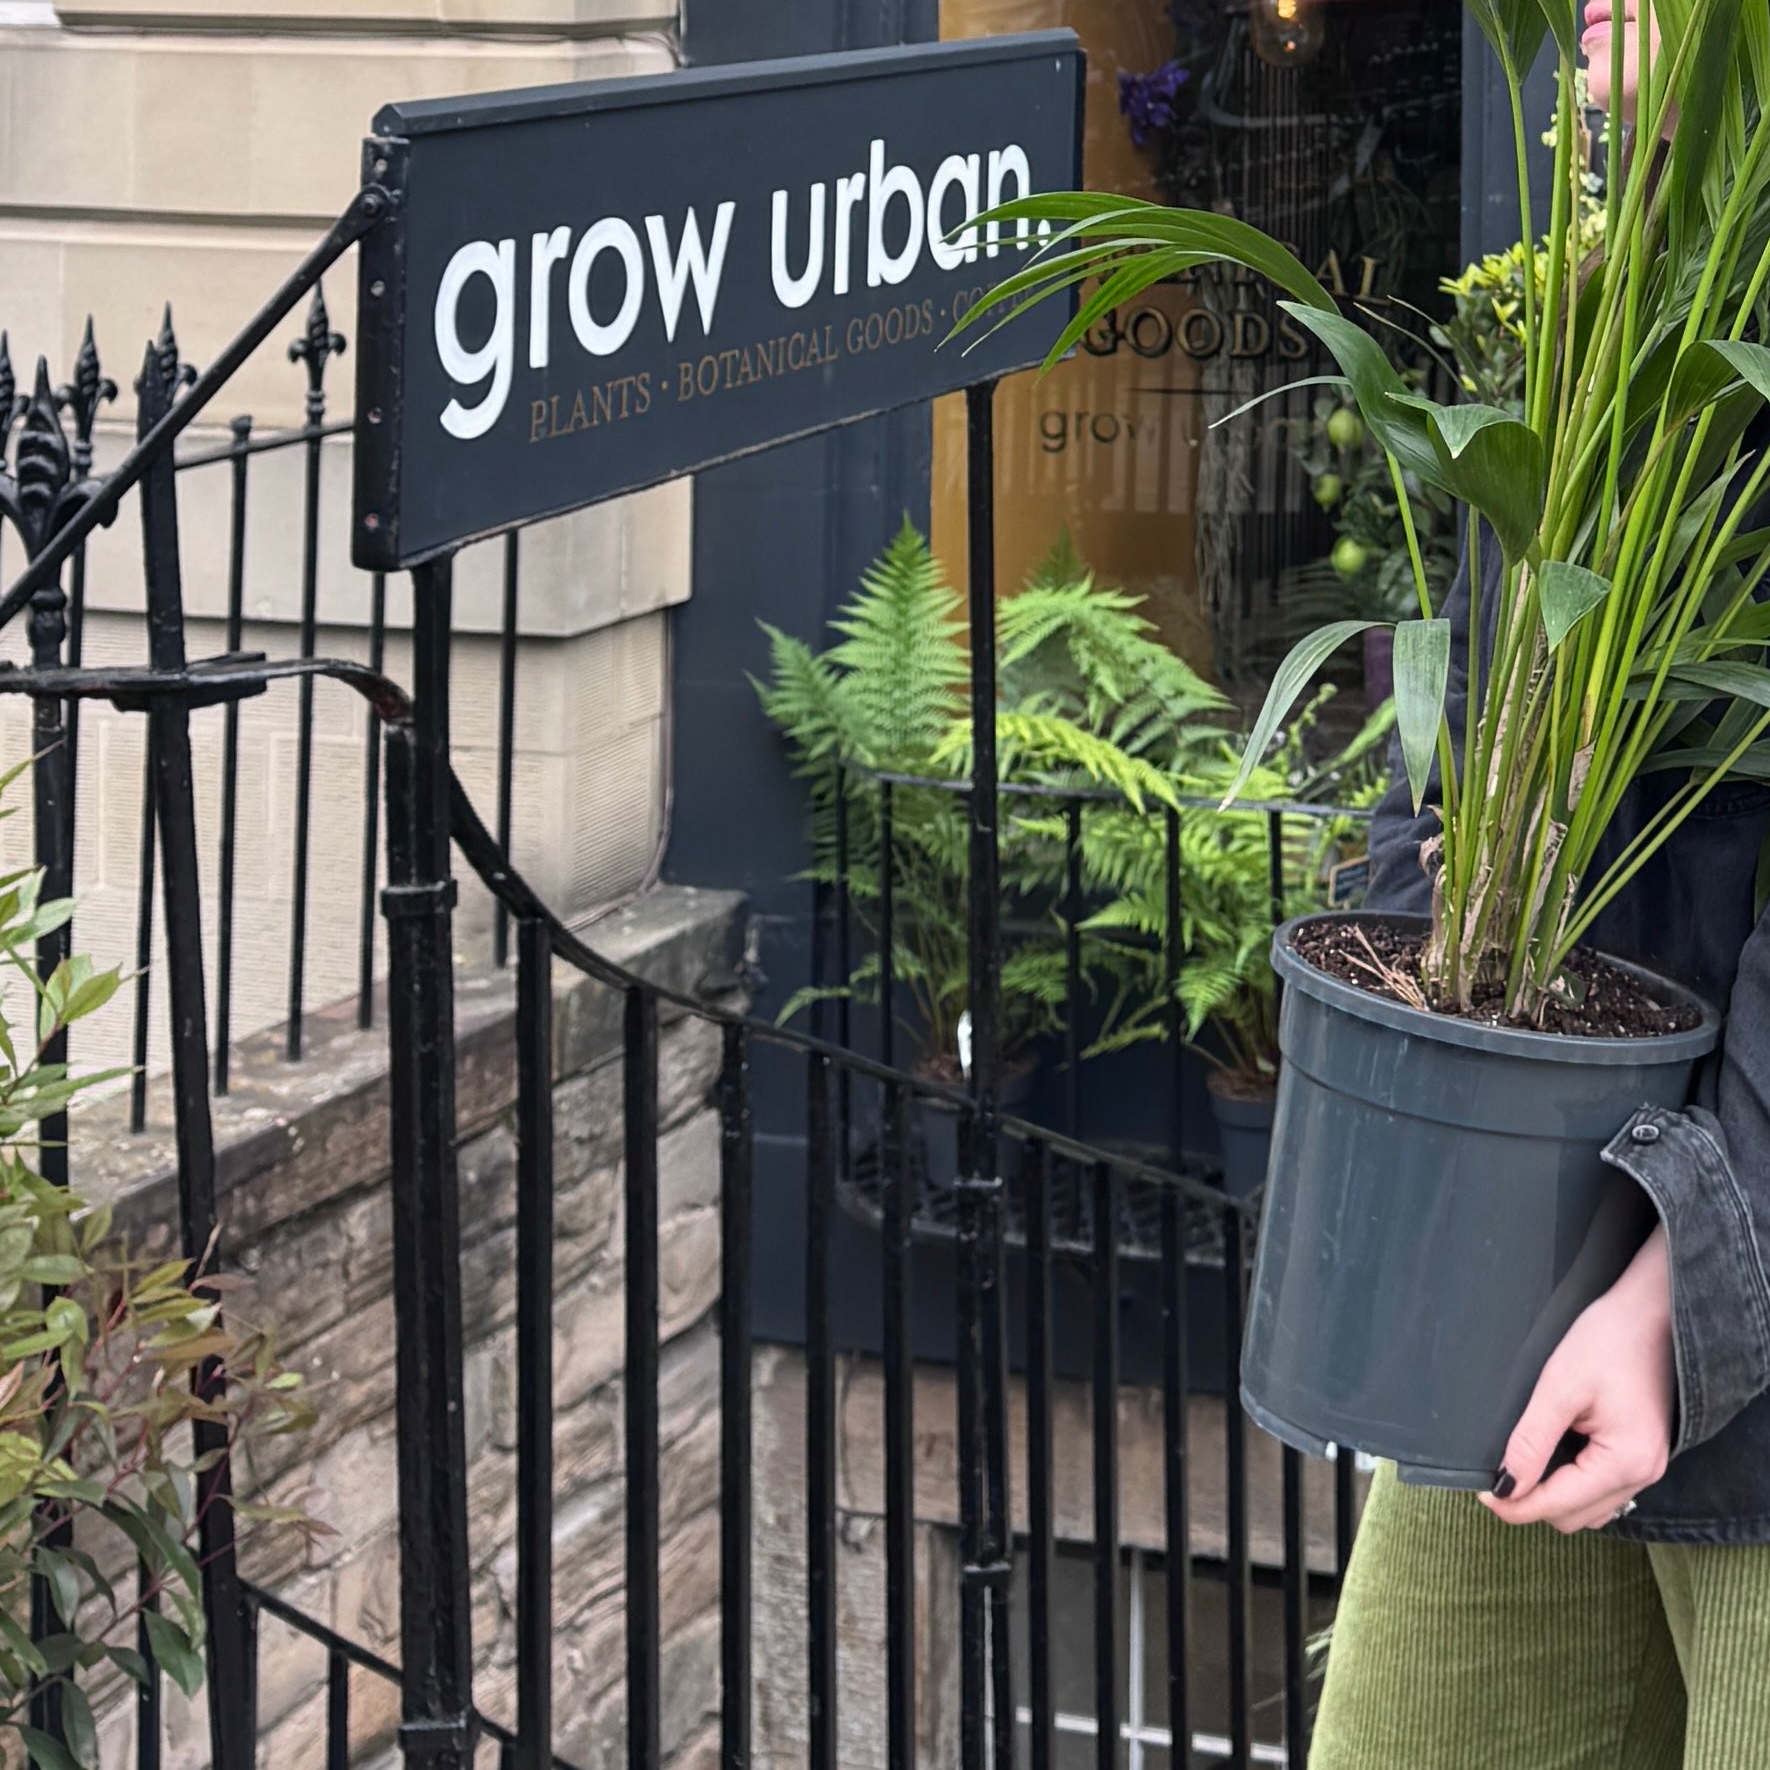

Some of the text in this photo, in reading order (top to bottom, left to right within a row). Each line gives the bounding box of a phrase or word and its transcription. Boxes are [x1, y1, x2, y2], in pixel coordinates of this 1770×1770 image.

[434, 200, 736, 440] grow
[1083, 306, 1310, 358] GOODS
[529, 371, 652, 444] PLANTS
[677, 324, 839, 403] BOTANICAL
[846, 297, 934, 356] GOODS
[1039, 409, 1156, 454] gro
